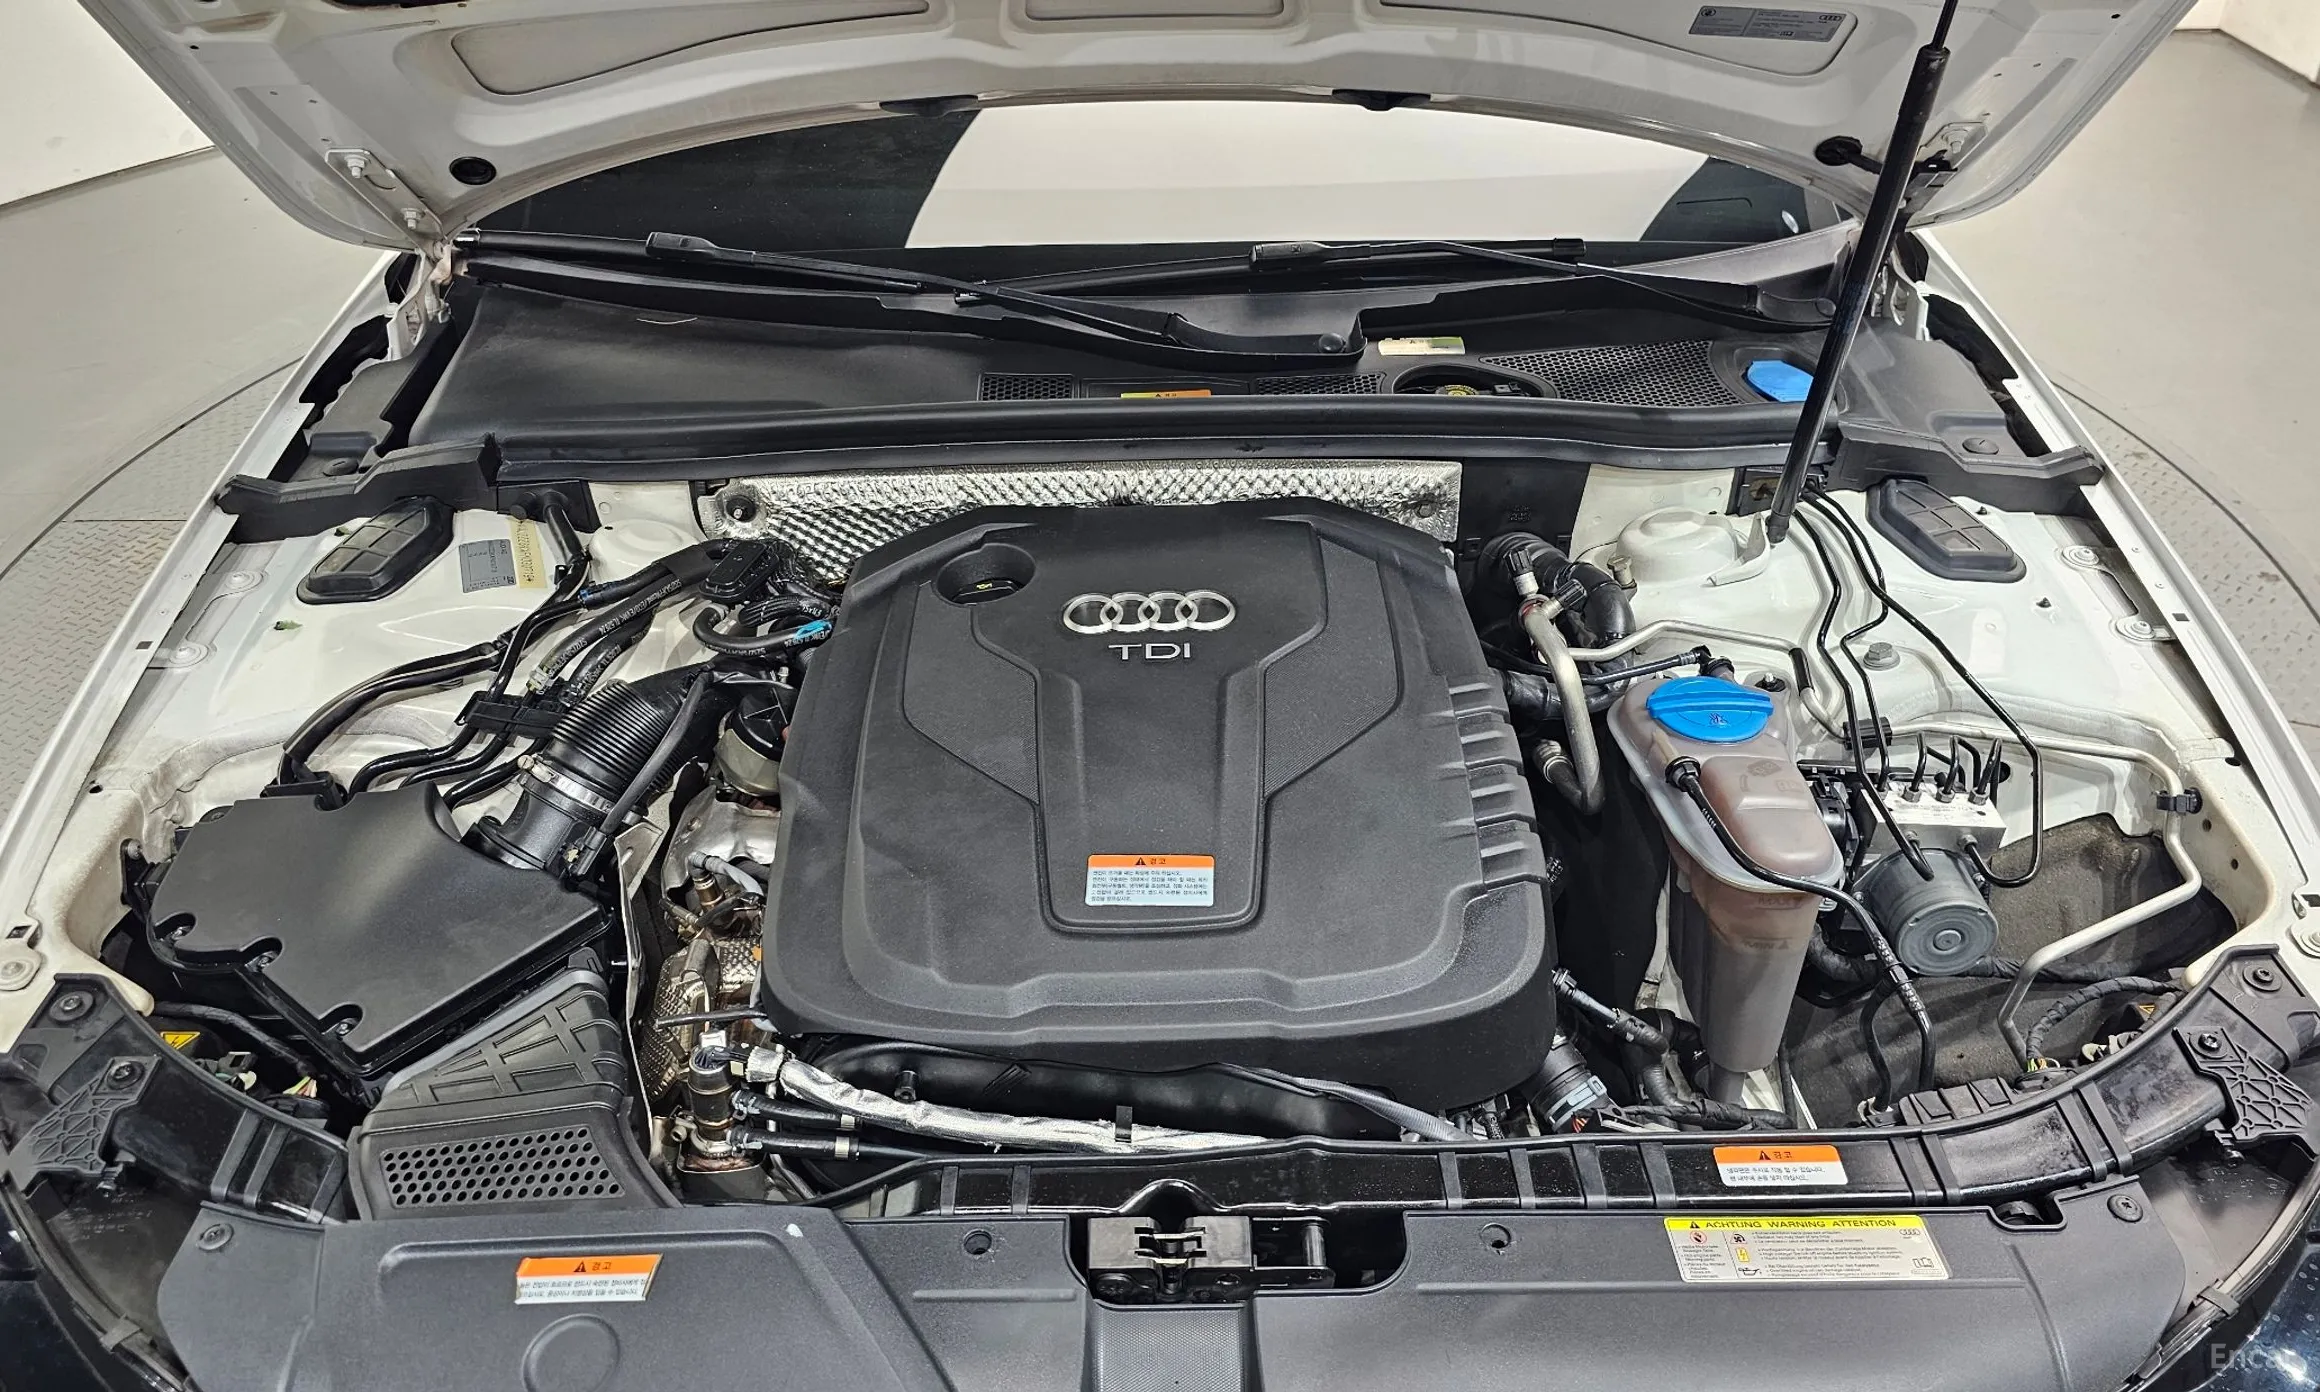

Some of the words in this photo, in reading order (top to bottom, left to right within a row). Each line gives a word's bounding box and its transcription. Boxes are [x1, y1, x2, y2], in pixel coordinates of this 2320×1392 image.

[1108, 643, 1191, 660] TDI
[1767, 1220, 1826, 1228] WARNING
[1832, 1219, 1897, 1228] ATTENTION
